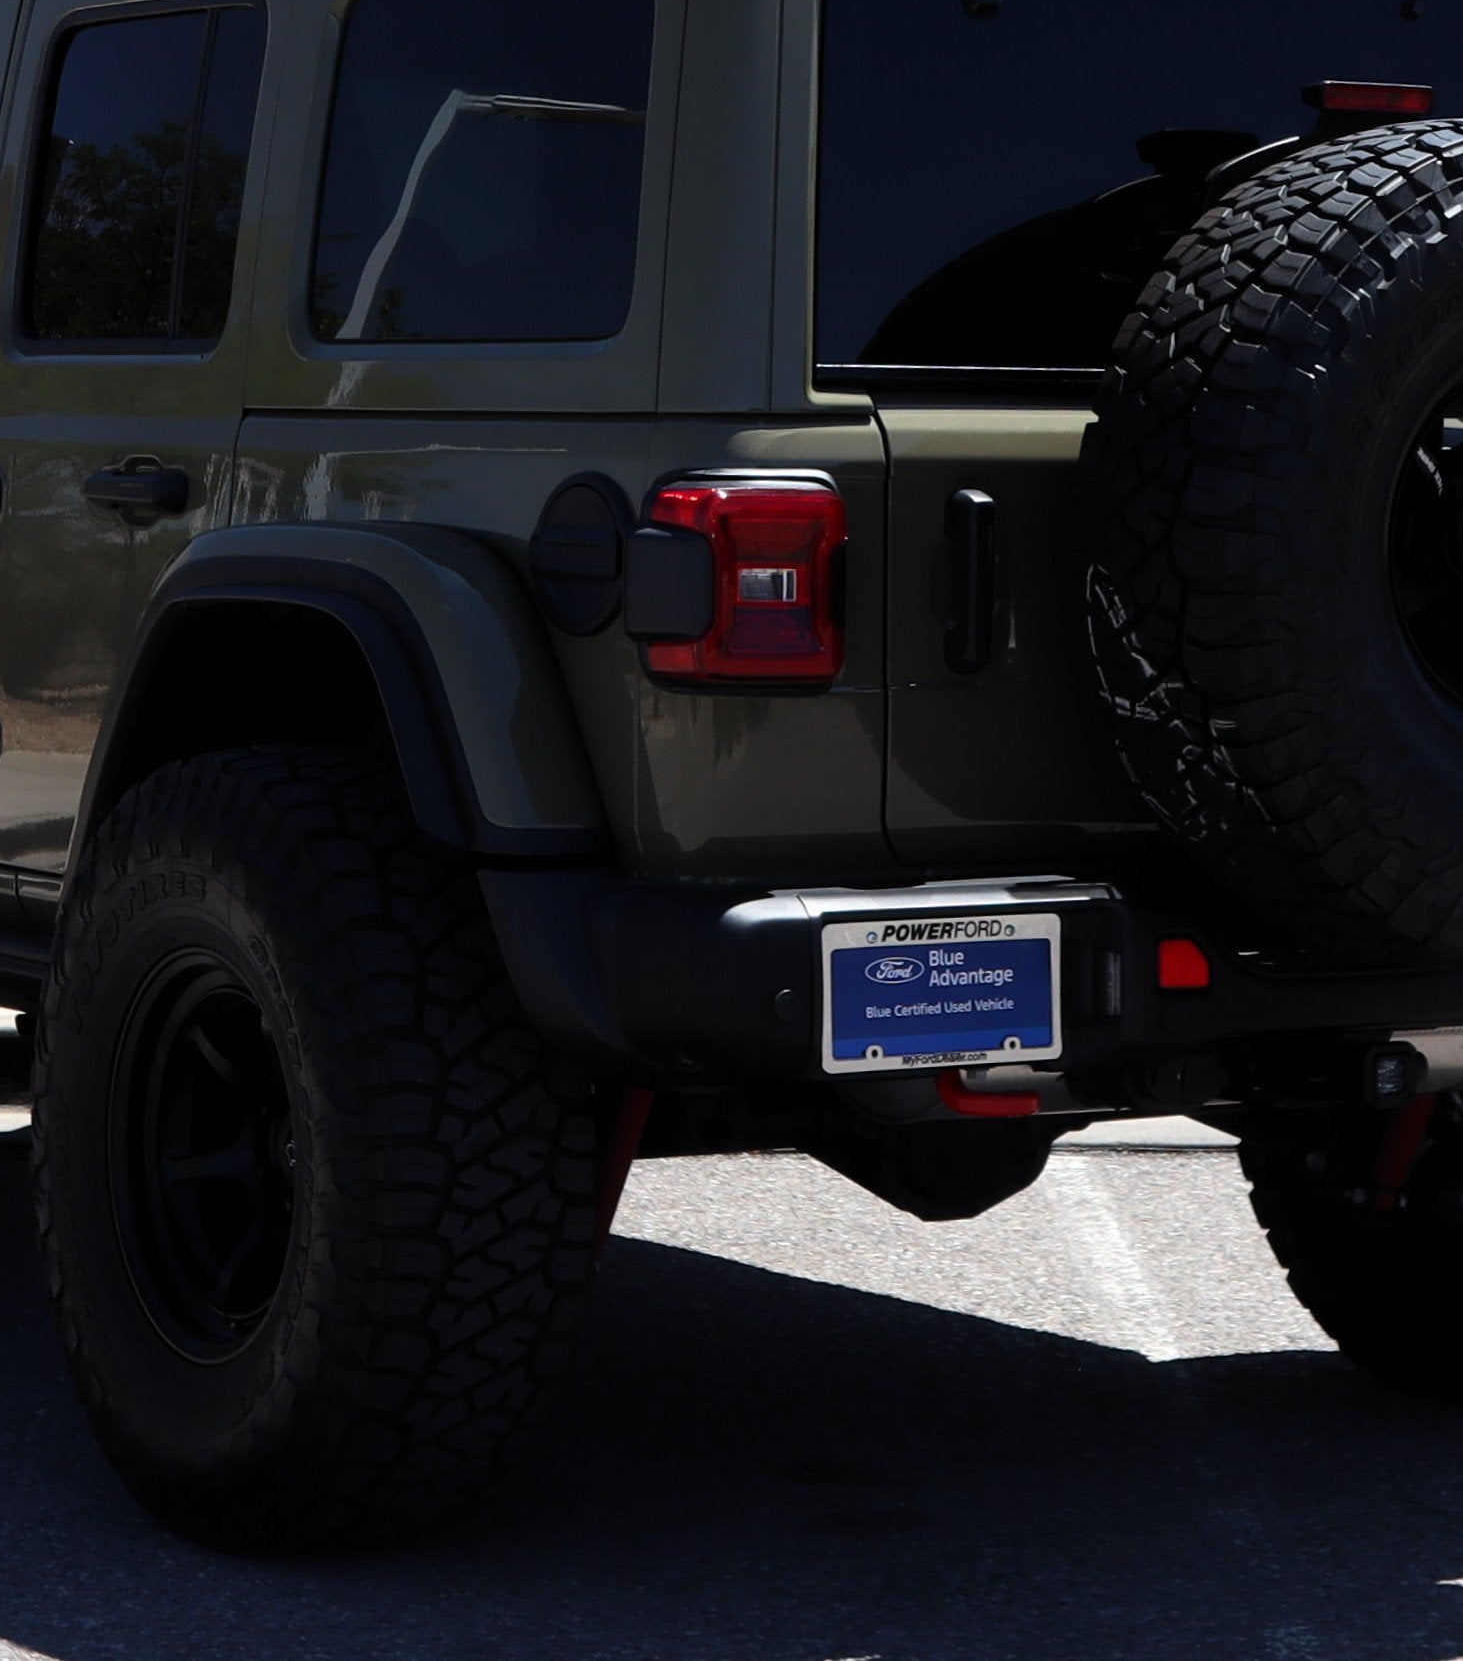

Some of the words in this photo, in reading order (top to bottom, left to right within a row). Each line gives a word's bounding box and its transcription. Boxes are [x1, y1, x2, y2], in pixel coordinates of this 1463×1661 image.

[881, 920, 1002, 942] POWERFORD
[929, 949, 965, 967] Blue
[876, 961, 914, 979] Ford
[929, 967, 1014, 987] Advantage
[866, 1006, 891, 1019] Blue
[894, 1002, 941, 1017] Certified
[944, 1000, 972, 1014] Used
[975, 997, 1014, 1011] Vehicle
